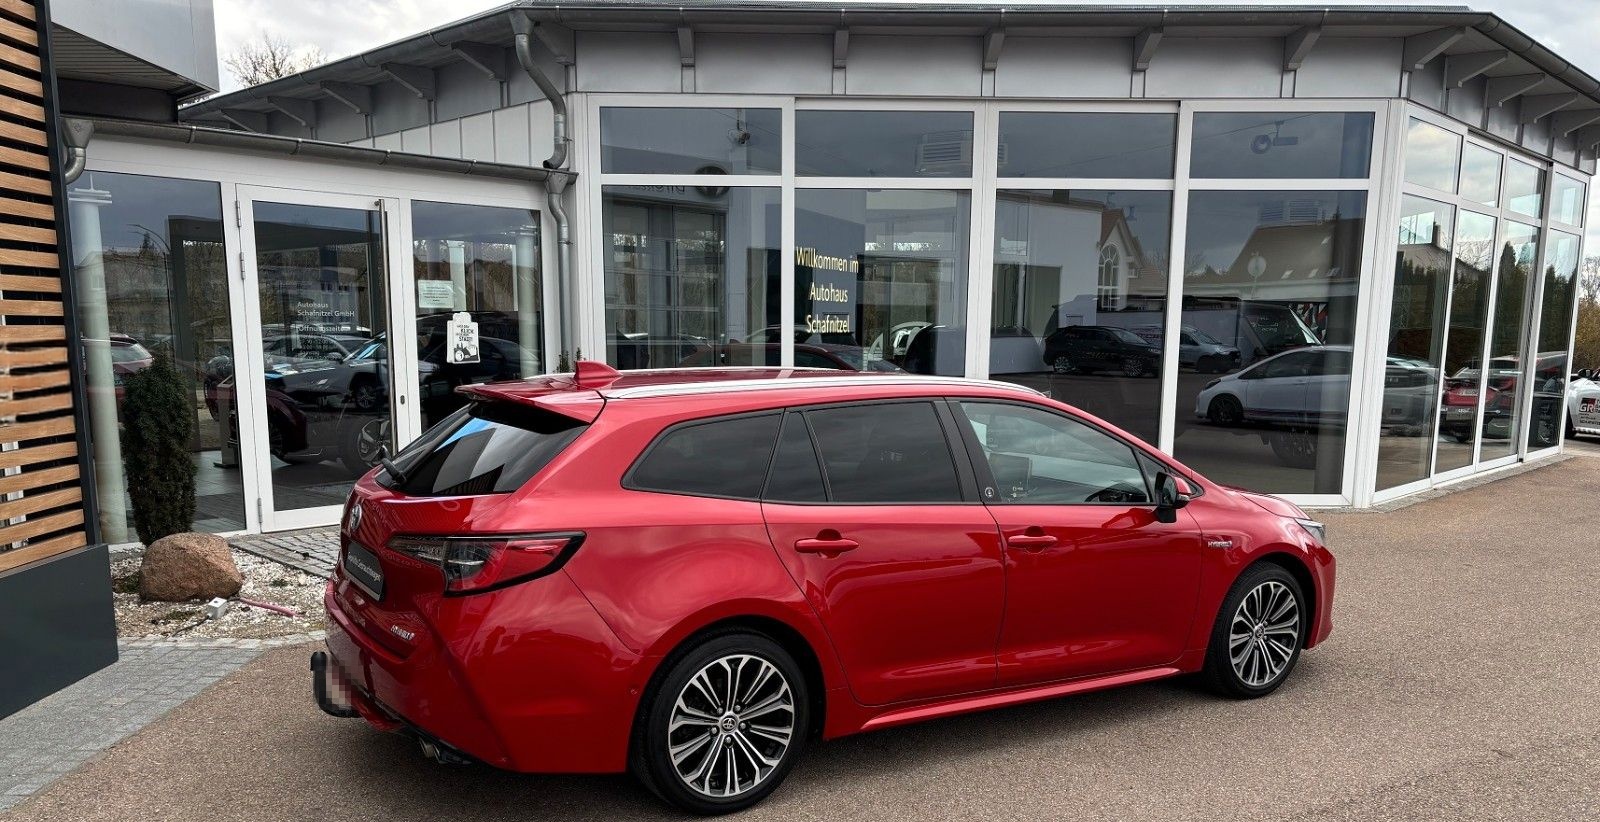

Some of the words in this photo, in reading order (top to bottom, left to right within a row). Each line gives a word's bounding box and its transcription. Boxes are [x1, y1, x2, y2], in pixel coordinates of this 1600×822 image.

[796, 246, 848, 271] Willkommen
[849, 255, 859, 273] im
[809, 281, 849, 303] Autohaus
[806, 314, 850, 333] Schafnitzel
[1580, 403, 1594, 413] GR
